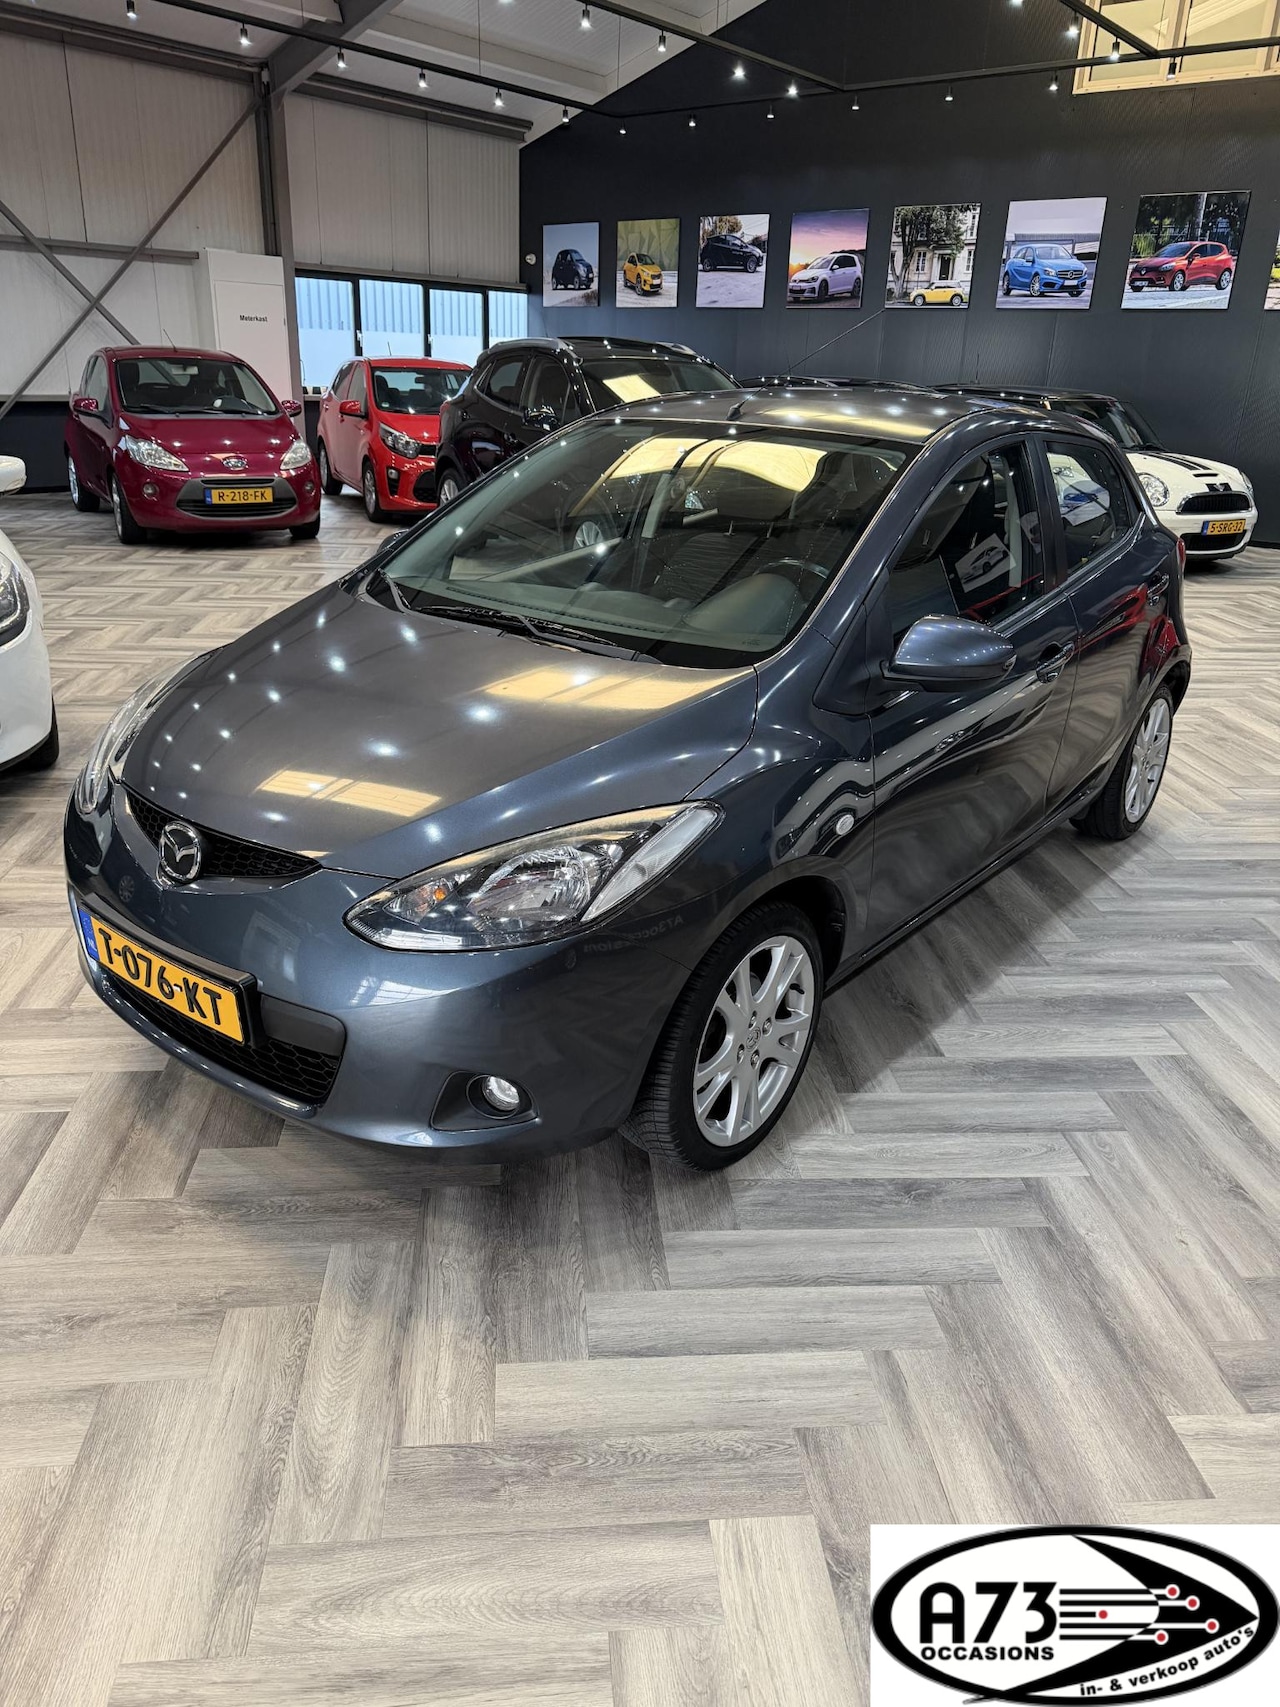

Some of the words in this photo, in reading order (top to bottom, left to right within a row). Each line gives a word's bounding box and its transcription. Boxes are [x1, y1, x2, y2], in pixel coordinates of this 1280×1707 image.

[240, 314, 268, 322] Meterkast
[218, 491, 268, 502] R-218-FK
[1210, 521, 1243, 534] 5-SRG-32
[98, 927, 222, 1026] T-076-KT
